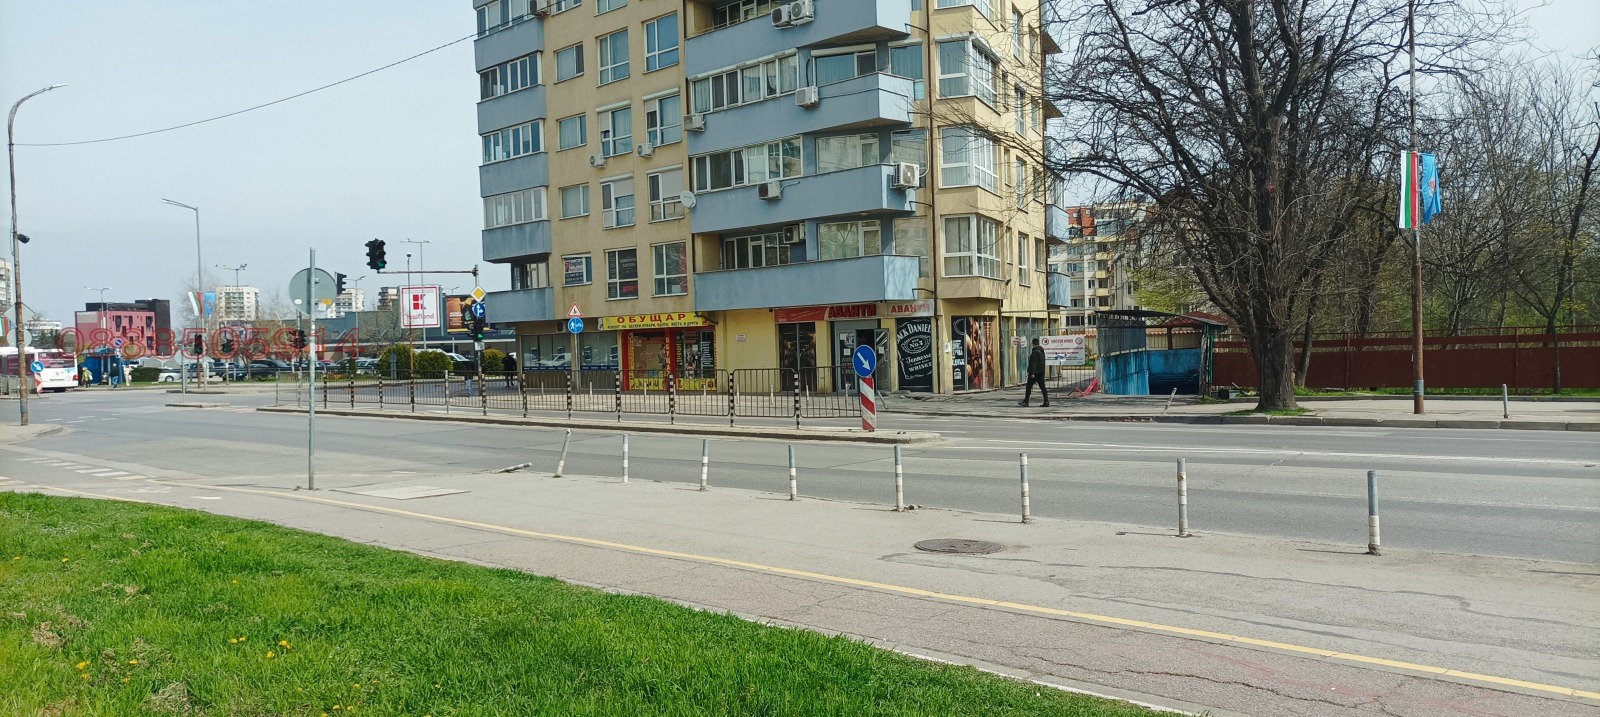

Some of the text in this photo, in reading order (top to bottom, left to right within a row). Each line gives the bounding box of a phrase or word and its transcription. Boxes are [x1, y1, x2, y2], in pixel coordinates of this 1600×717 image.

[828, 304, 876, 318] АВАНТИ
[891, 304, 929, 313] АВАНТИ
[617, 314, 686, 324] ОБУЩАР
